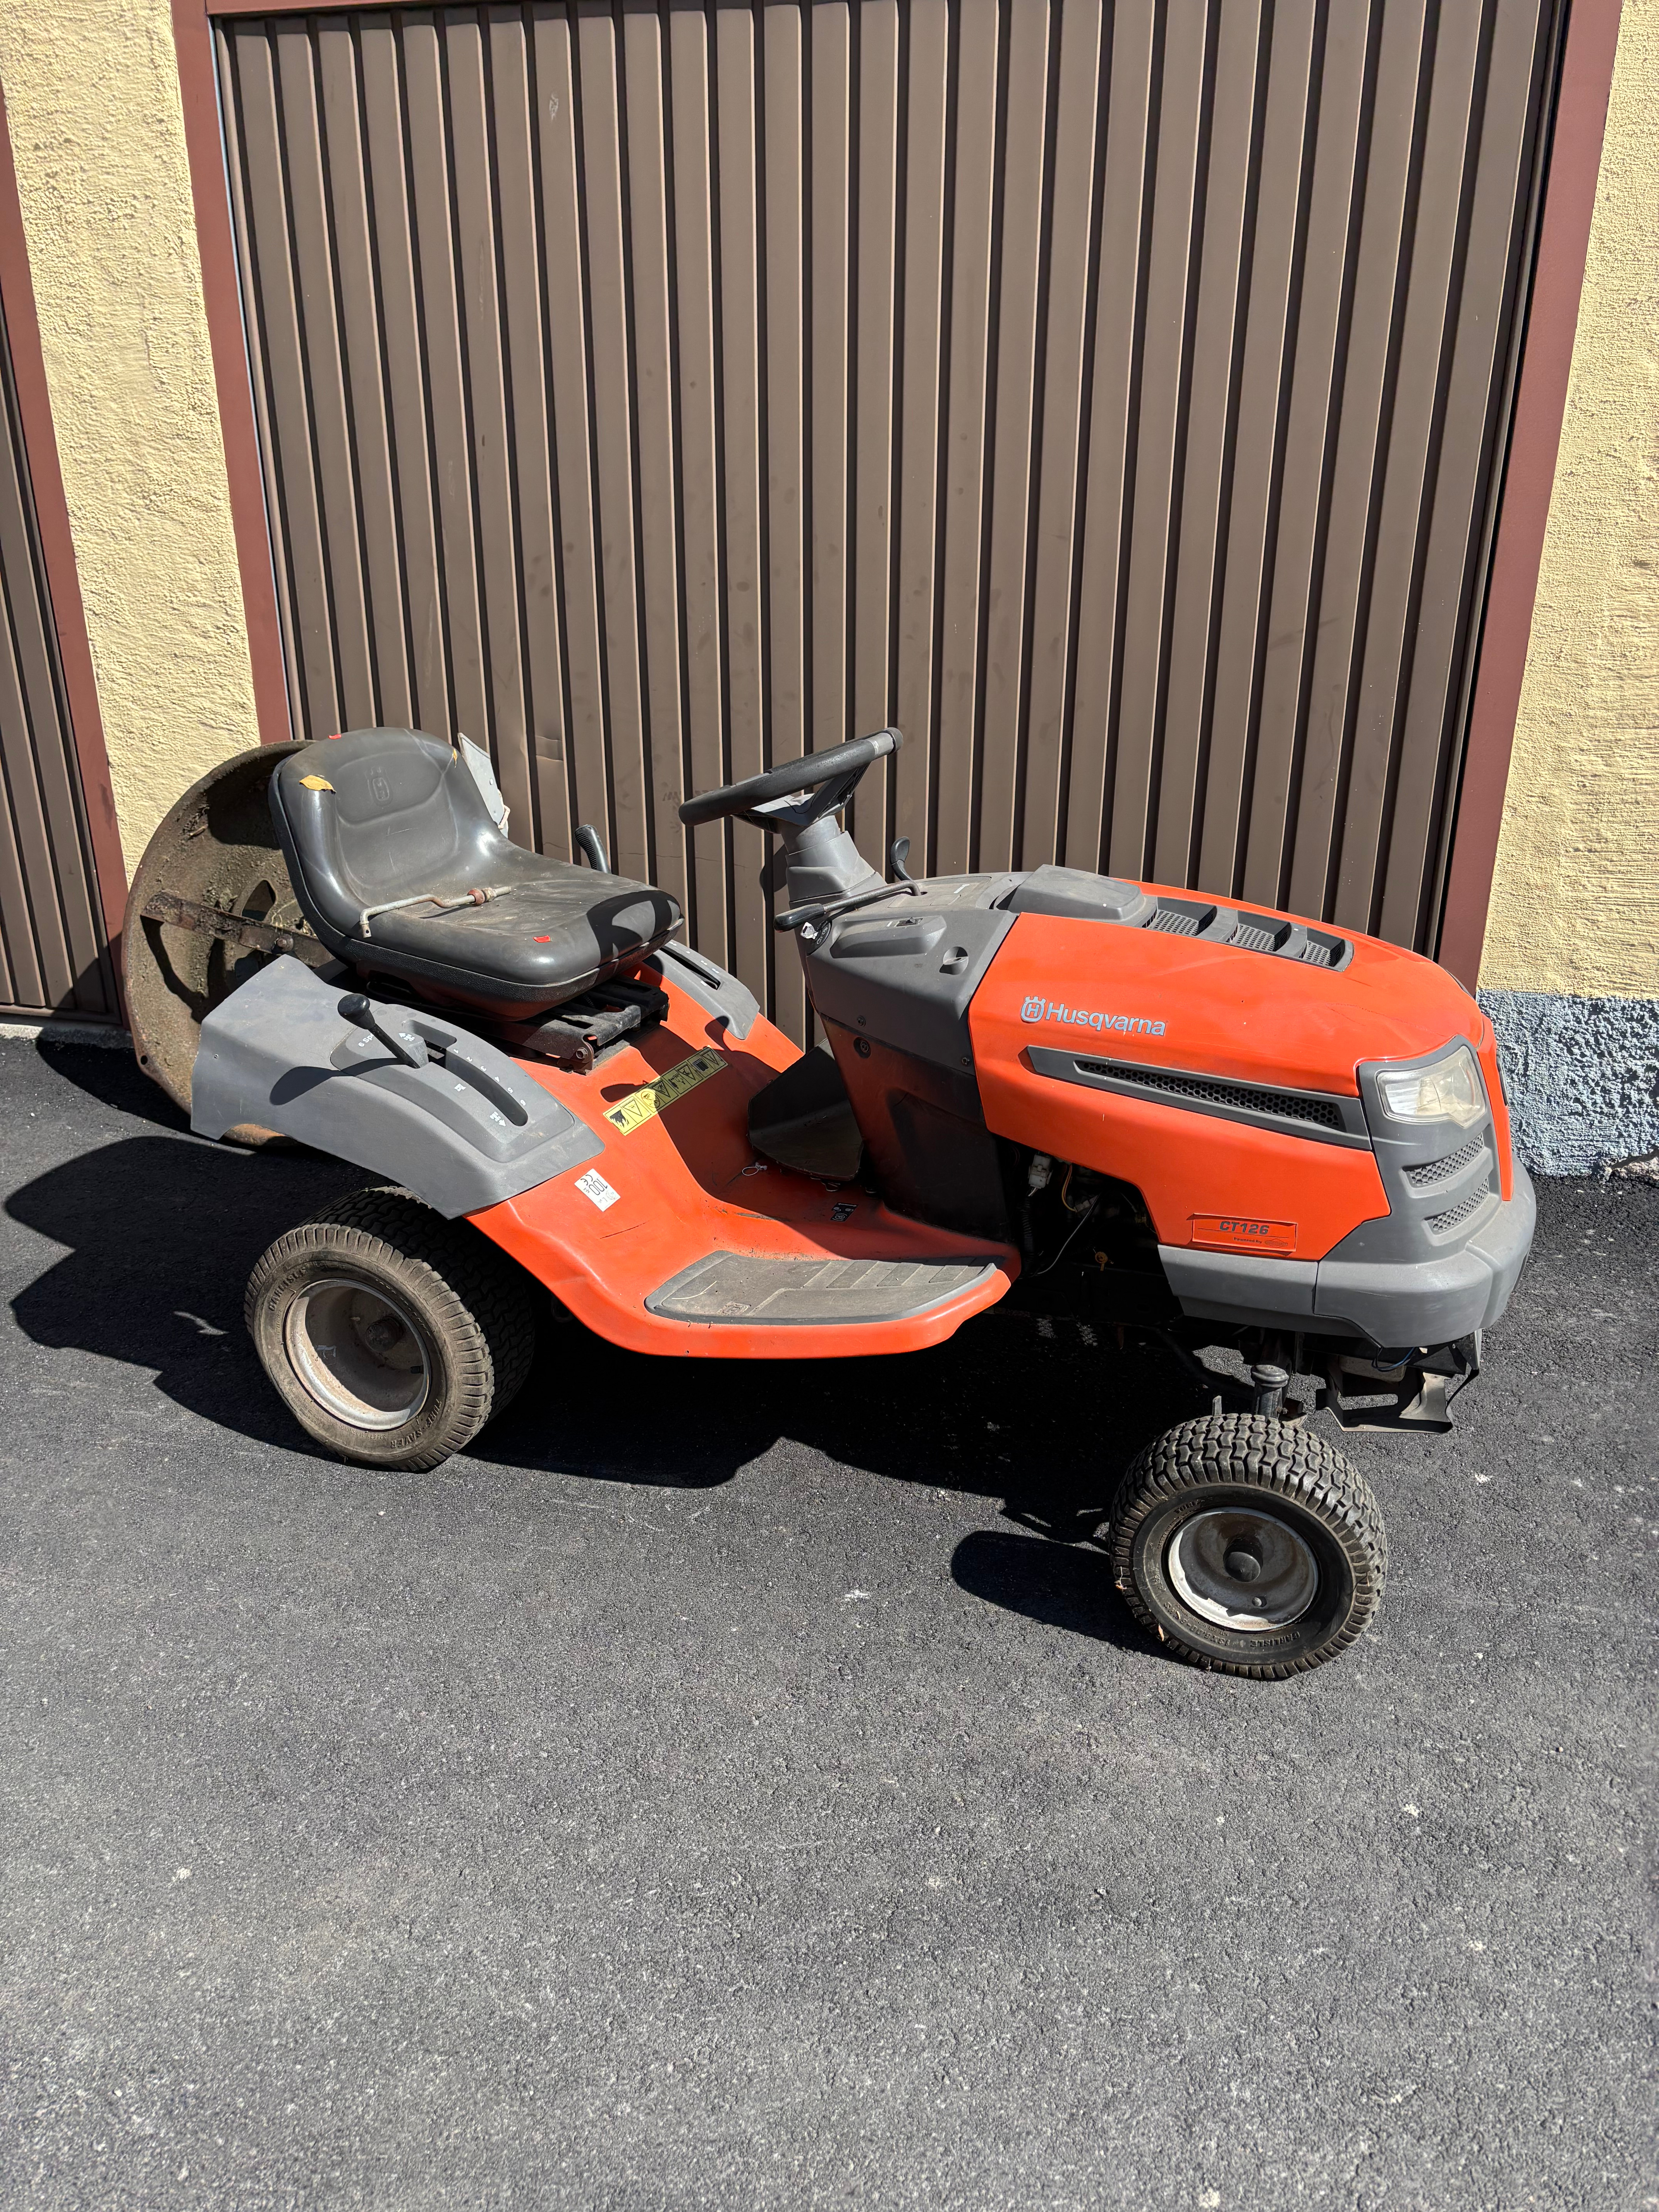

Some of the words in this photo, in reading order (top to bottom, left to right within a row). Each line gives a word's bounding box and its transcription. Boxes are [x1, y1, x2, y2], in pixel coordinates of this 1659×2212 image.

[1045, 1002, 1166, 1036] Husqvarna
[589, 1178, 608, 1195] 100
[1220, 1221, 1269, 1235] CT126
[1250, 1631, 1300, 1647] CARLISLE
